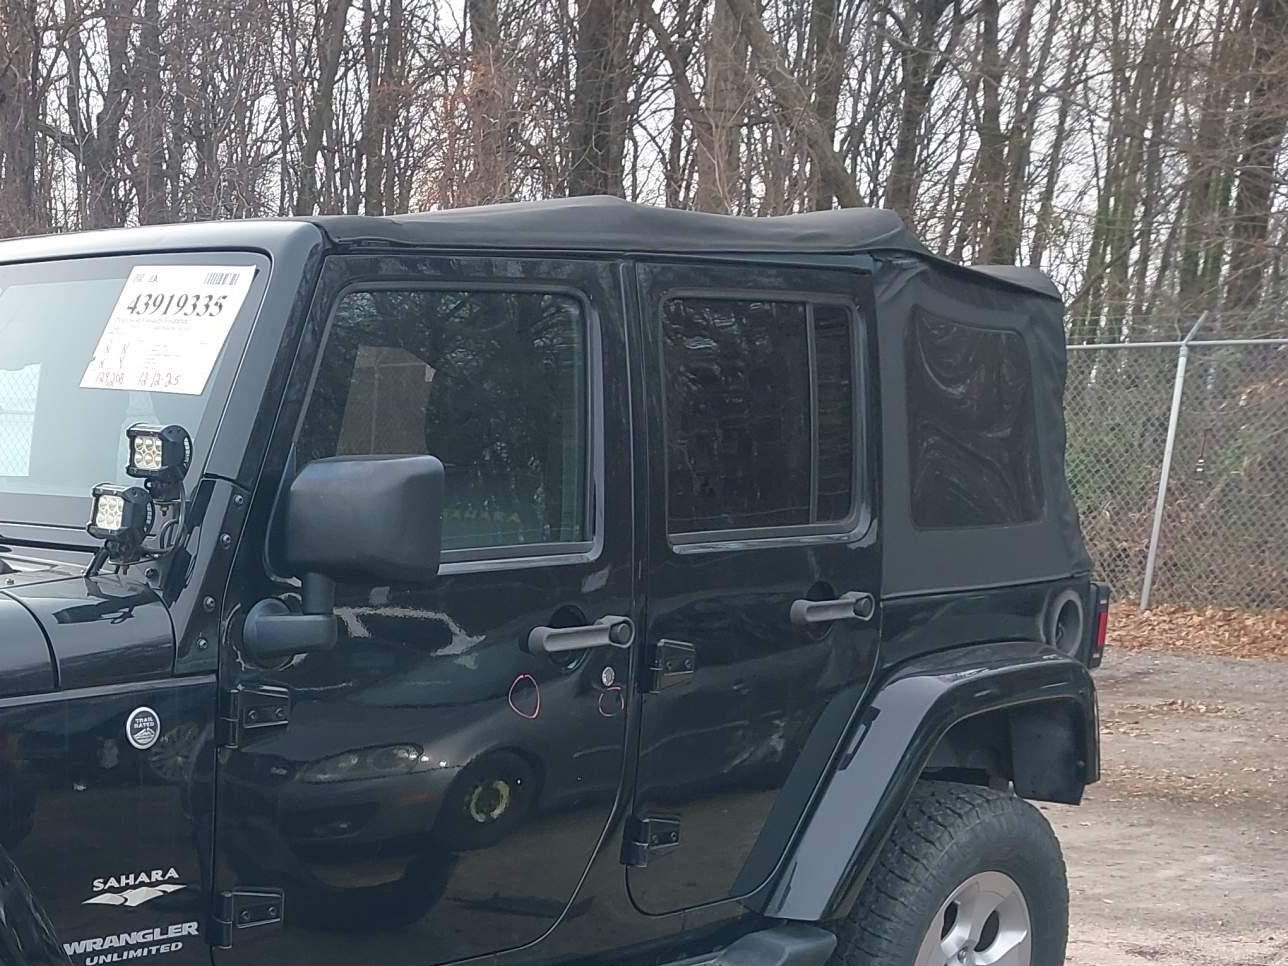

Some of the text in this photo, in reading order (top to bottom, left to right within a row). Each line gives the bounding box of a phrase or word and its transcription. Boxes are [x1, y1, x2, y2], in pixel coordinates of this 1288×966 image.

[127, 293, 229, 317] 43919335
[92, 867, 179, 892] SAHARA
[63, 921, 199, 956] WRANGLER
[85, 941, 184, 966] UNLIMITED
